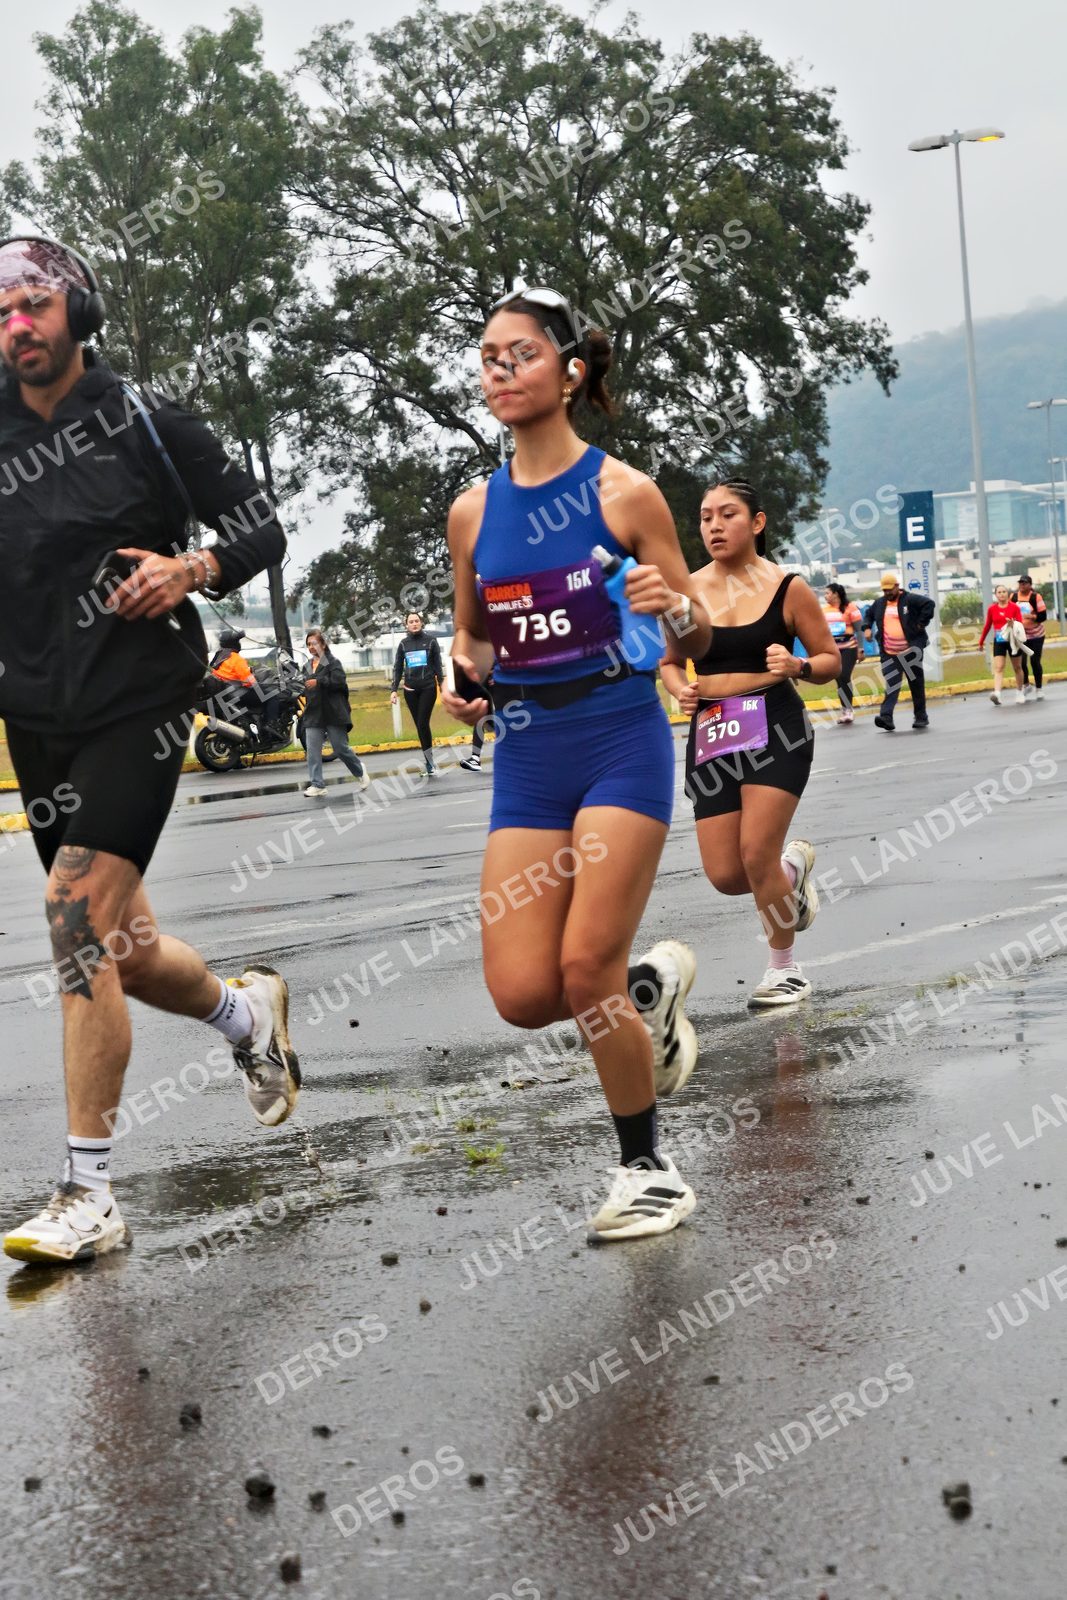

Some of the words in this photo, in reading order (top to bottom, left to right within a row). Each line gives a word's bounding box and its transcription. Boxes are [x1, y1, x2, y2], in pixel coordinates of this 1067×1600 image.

[906, 517, 926, 543] E
[512, 609, 571, 643] 736
[707, 719, 740, 743] 570
